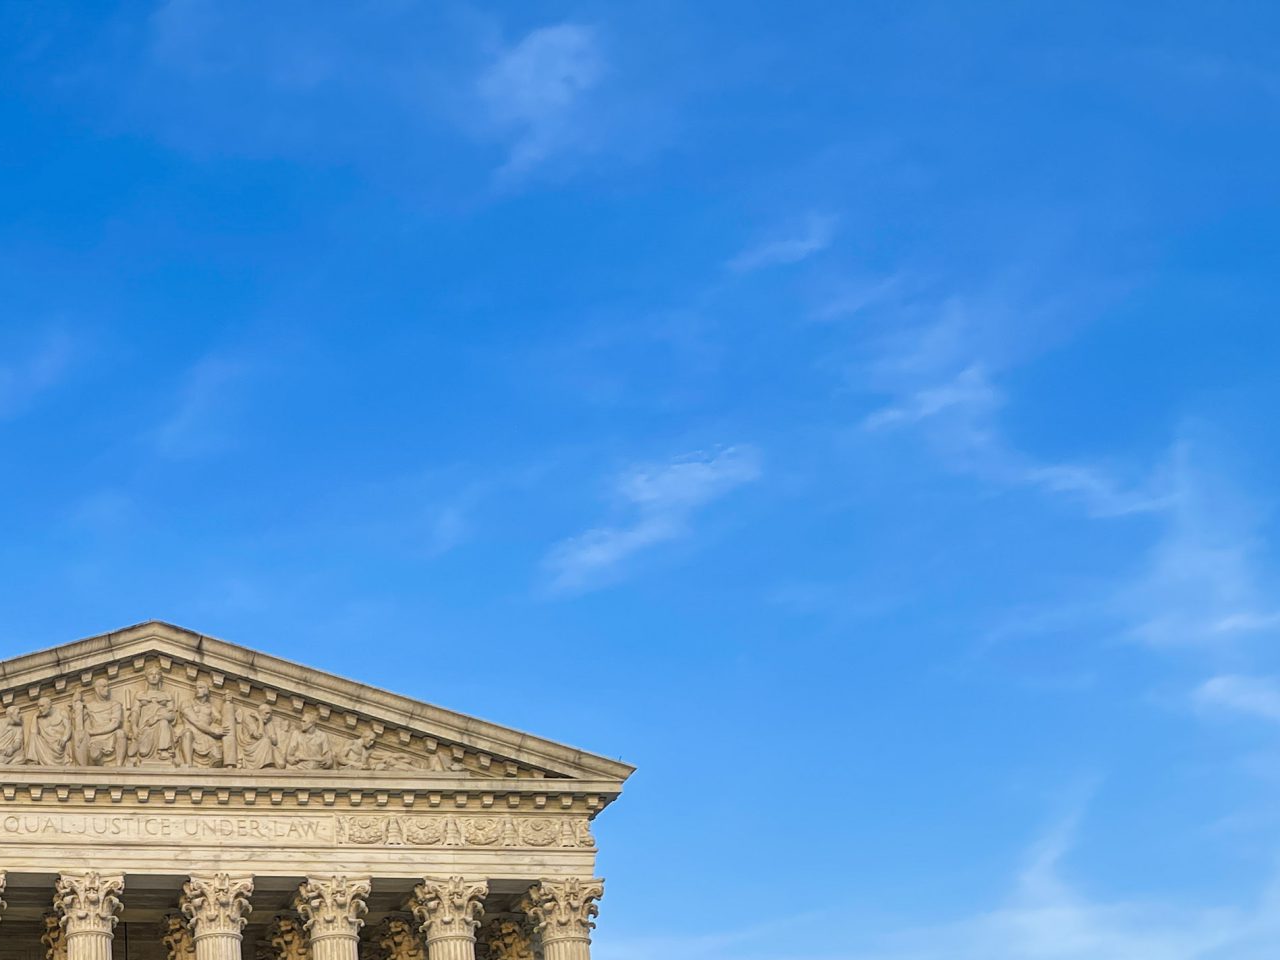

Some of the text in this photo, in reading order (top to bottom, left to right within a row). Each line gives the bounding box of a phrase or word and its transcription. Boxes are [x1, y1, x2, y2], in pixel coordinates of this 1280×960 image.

[77, 817, 171, 836] JUSTICE
[184, 819, 266, 838] UNDER
[273, 820, 321, 838] LAW
